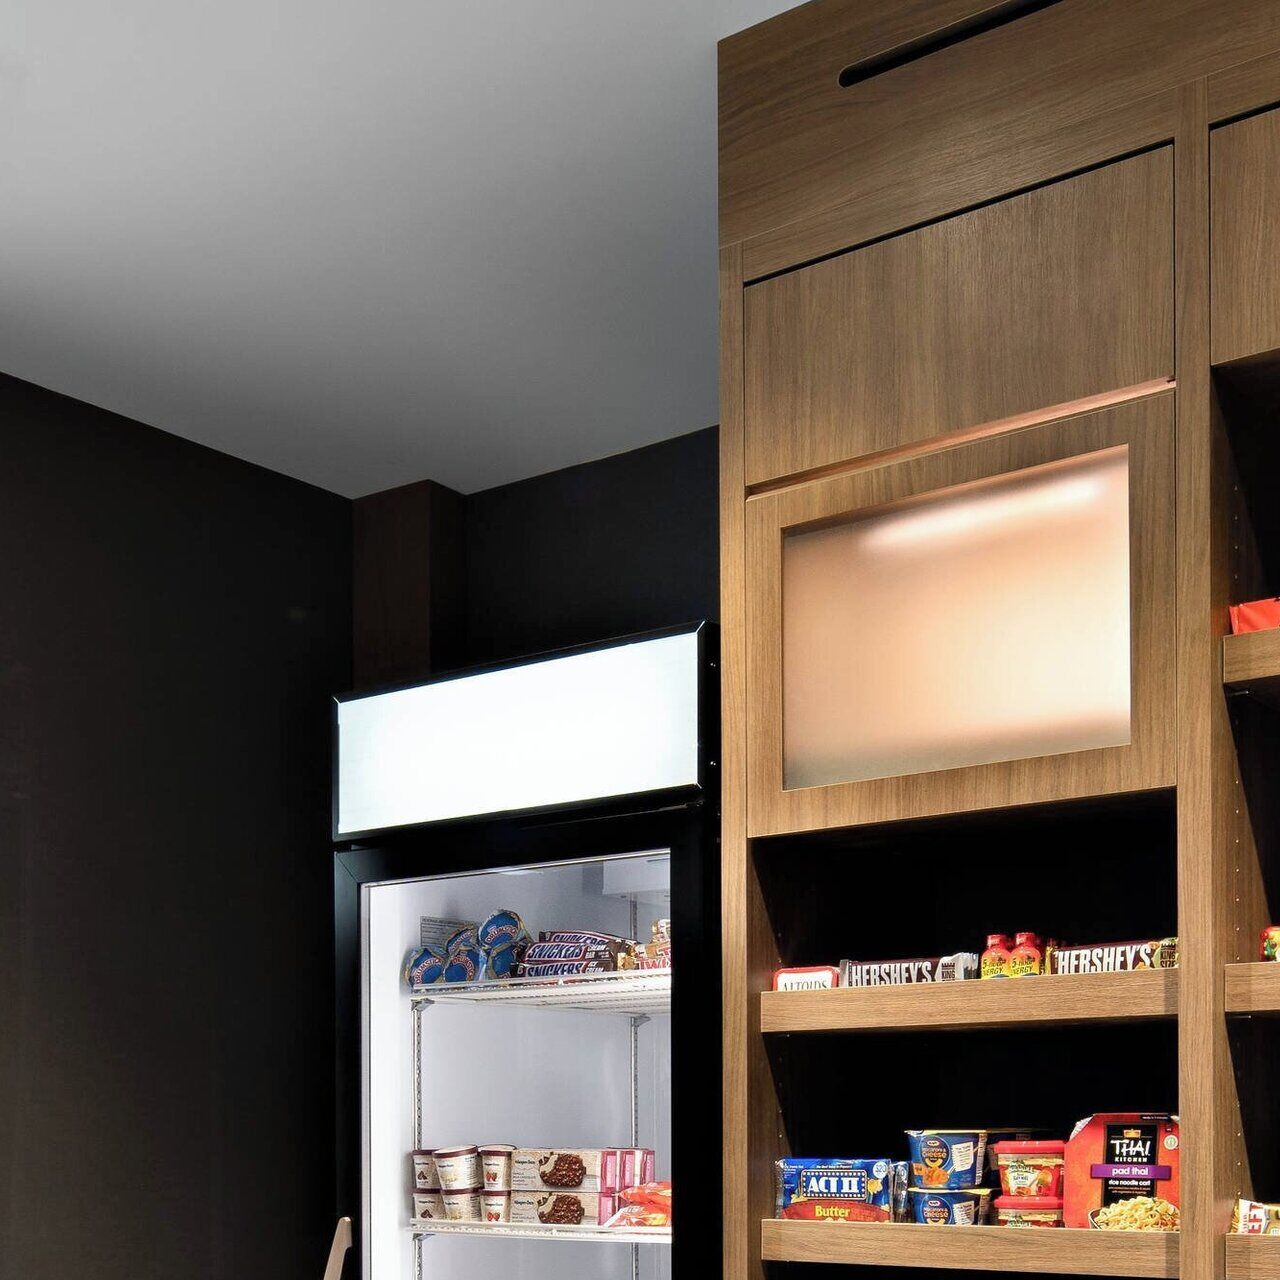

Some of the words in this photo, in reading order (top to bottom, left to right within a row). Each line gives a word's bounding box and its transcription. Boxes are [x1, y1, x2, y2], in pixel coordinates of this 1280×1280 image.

[527, 943, 584, 959] SNICKERS
[1159, 951, 1176, 960] KING
[1057, 944, 1152, 975] HERSHEY'S
[527, 962, 584, 977] SNICKERS
[852, 961, 933, 987] HERSHEY'S
[941, 970, 956, 979] KING
[1110, 1139, 1152, 1156] THAI
[1111, 1166, 1131, 1177] pad
[1131, 1166, 1149, 1175] thai
[806, 1176, 840, 1194] ACT
[841, 1176, 860, 1193] II
[814, 1205, 851, 1217] Butter
